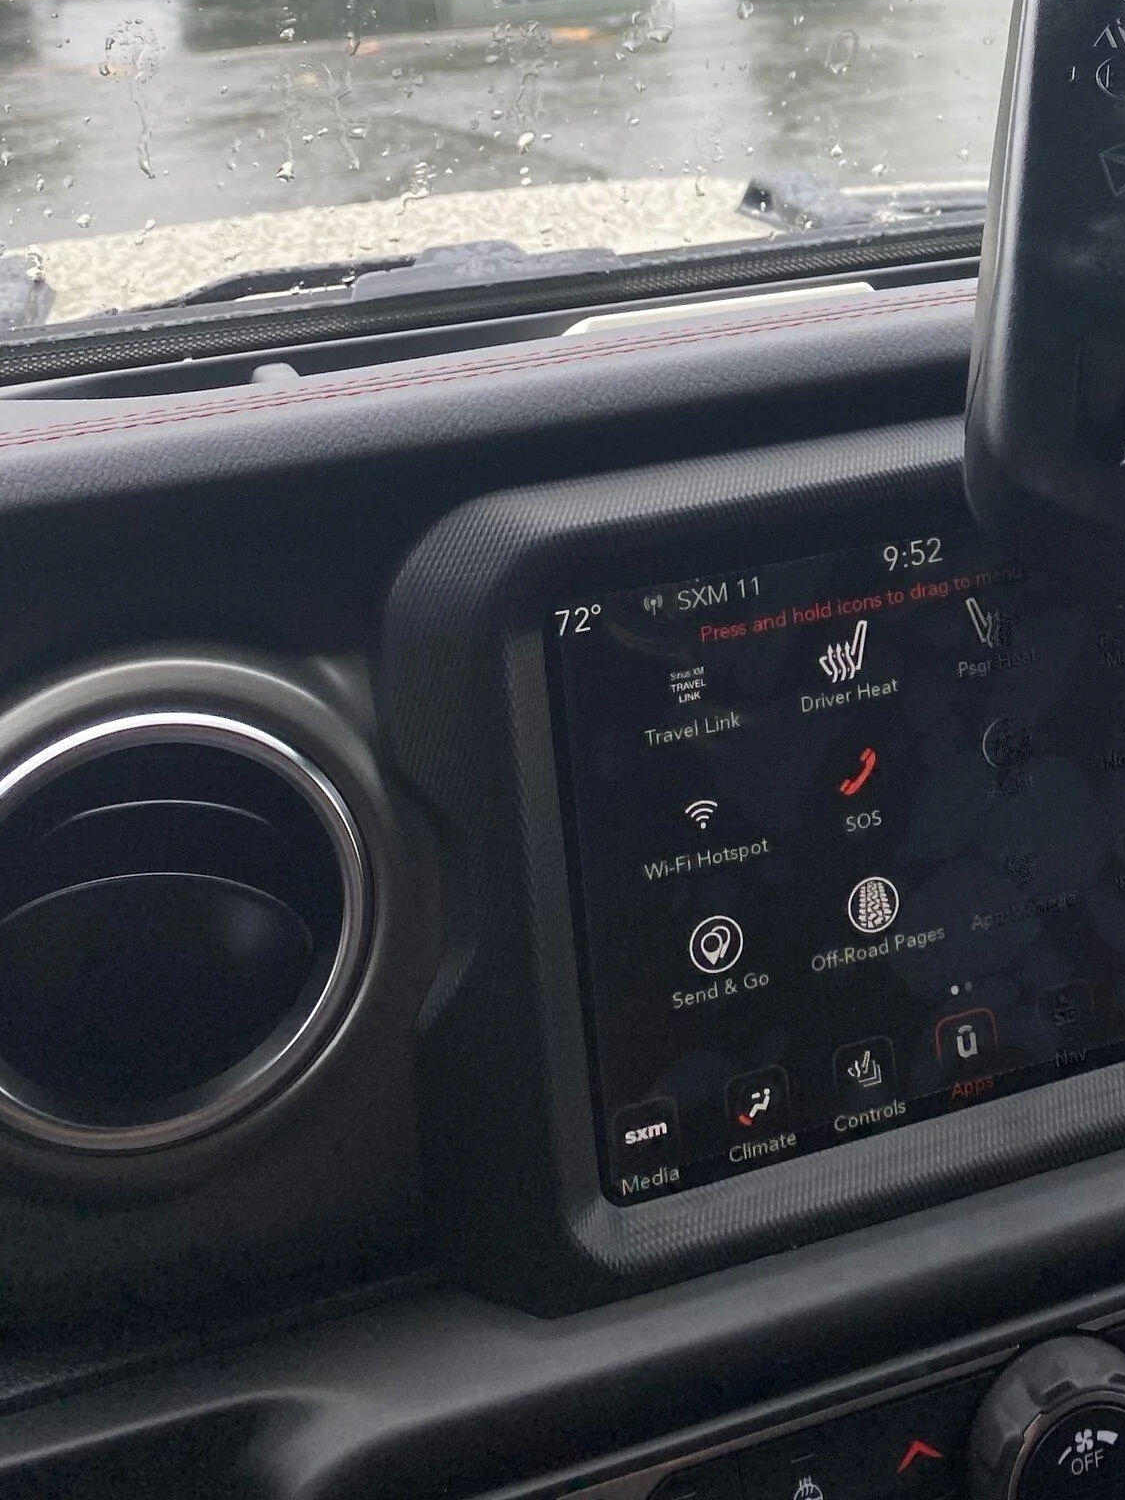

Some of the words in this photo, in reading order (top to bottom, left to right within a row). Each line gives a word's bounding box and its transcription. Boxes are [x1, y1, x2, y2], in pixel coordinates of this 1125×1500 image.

[883, 537, 943, 571] 9:52
[677, 583, 729, 611] SXM
[737, 576, 761, 598] 11
[555, 604, 601, 636] 72°
[701, 619, 747, 644] Press
[752, 606, 787, 633] and
[793, 601, 832, 625] hold
[838, 596, 882, 615] icons
[886, 588, 904, 605] to
[910, 580, 949, 603] drag
[952, 575, 970, 591] to
[957, 657, 993, 678] Psgr
[670, 679, 707, 693] TRAVEL
[678, 691, 702, 704] LINK
[801, 690, 852, 713] Driver
[857, 678, 898, 700] Heat
[645, 720, 699, 747] Travel
[705, 712, 741, 735] Link
[846, 809, 882, 833] SOS
[644, 855, 692, 880] Wi-Fi
[697, 838, 770, 868] Hotspot
[811, 939, 889, 972] Off-Road
[895, 926, 945, 956] Pages
[672, 982, 719, 1009] Send
[725, 977, 738, 994] &
[744, 971, 770, 989] Go
[1056, 1048, 1087, 1068] Nav
[951, 1075, 994, 1100] Apps
[834, 1100, 906, 1132] Controls
[624, 1120, 668, 1144] sxm
[729, 1132, 797, 1163] Climate
[621, 1166, 680, 1196] Media
[1071, 1448, 1104, 1476] OFF
